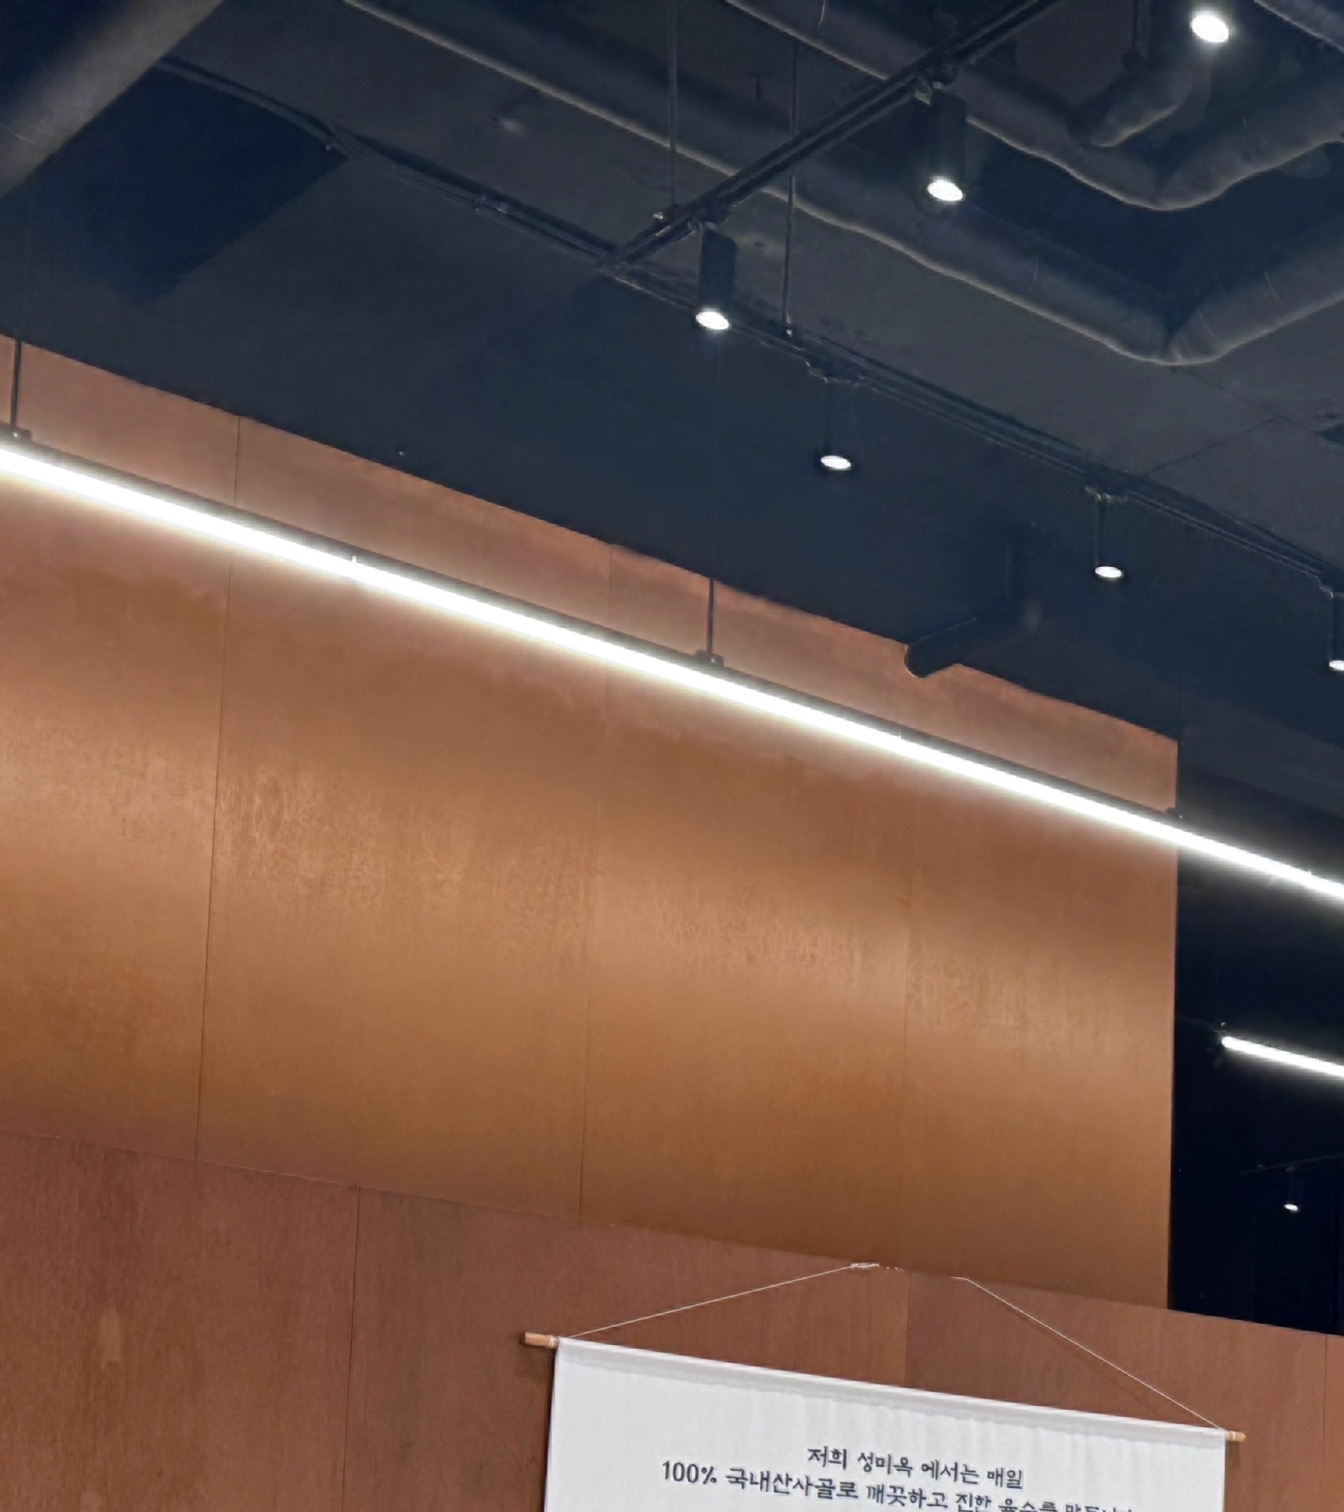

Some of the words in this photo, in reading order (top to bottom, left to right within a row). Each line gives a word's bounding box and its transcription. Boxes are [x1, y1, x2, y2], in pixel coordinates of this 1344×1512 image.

[662, 1460, 718, 1485] 100%
[725, 1464, 859, 1500] 국내산사골로
[866, 1483, 949, 1509] 깨끗하고
[807, 1445, 848, 1470] 저희
[857, 1451, 914, 1478] 성미옥
[920, 1459, 980, 1485] 에서는
[986, 1467, 1023, 1490] 매일
